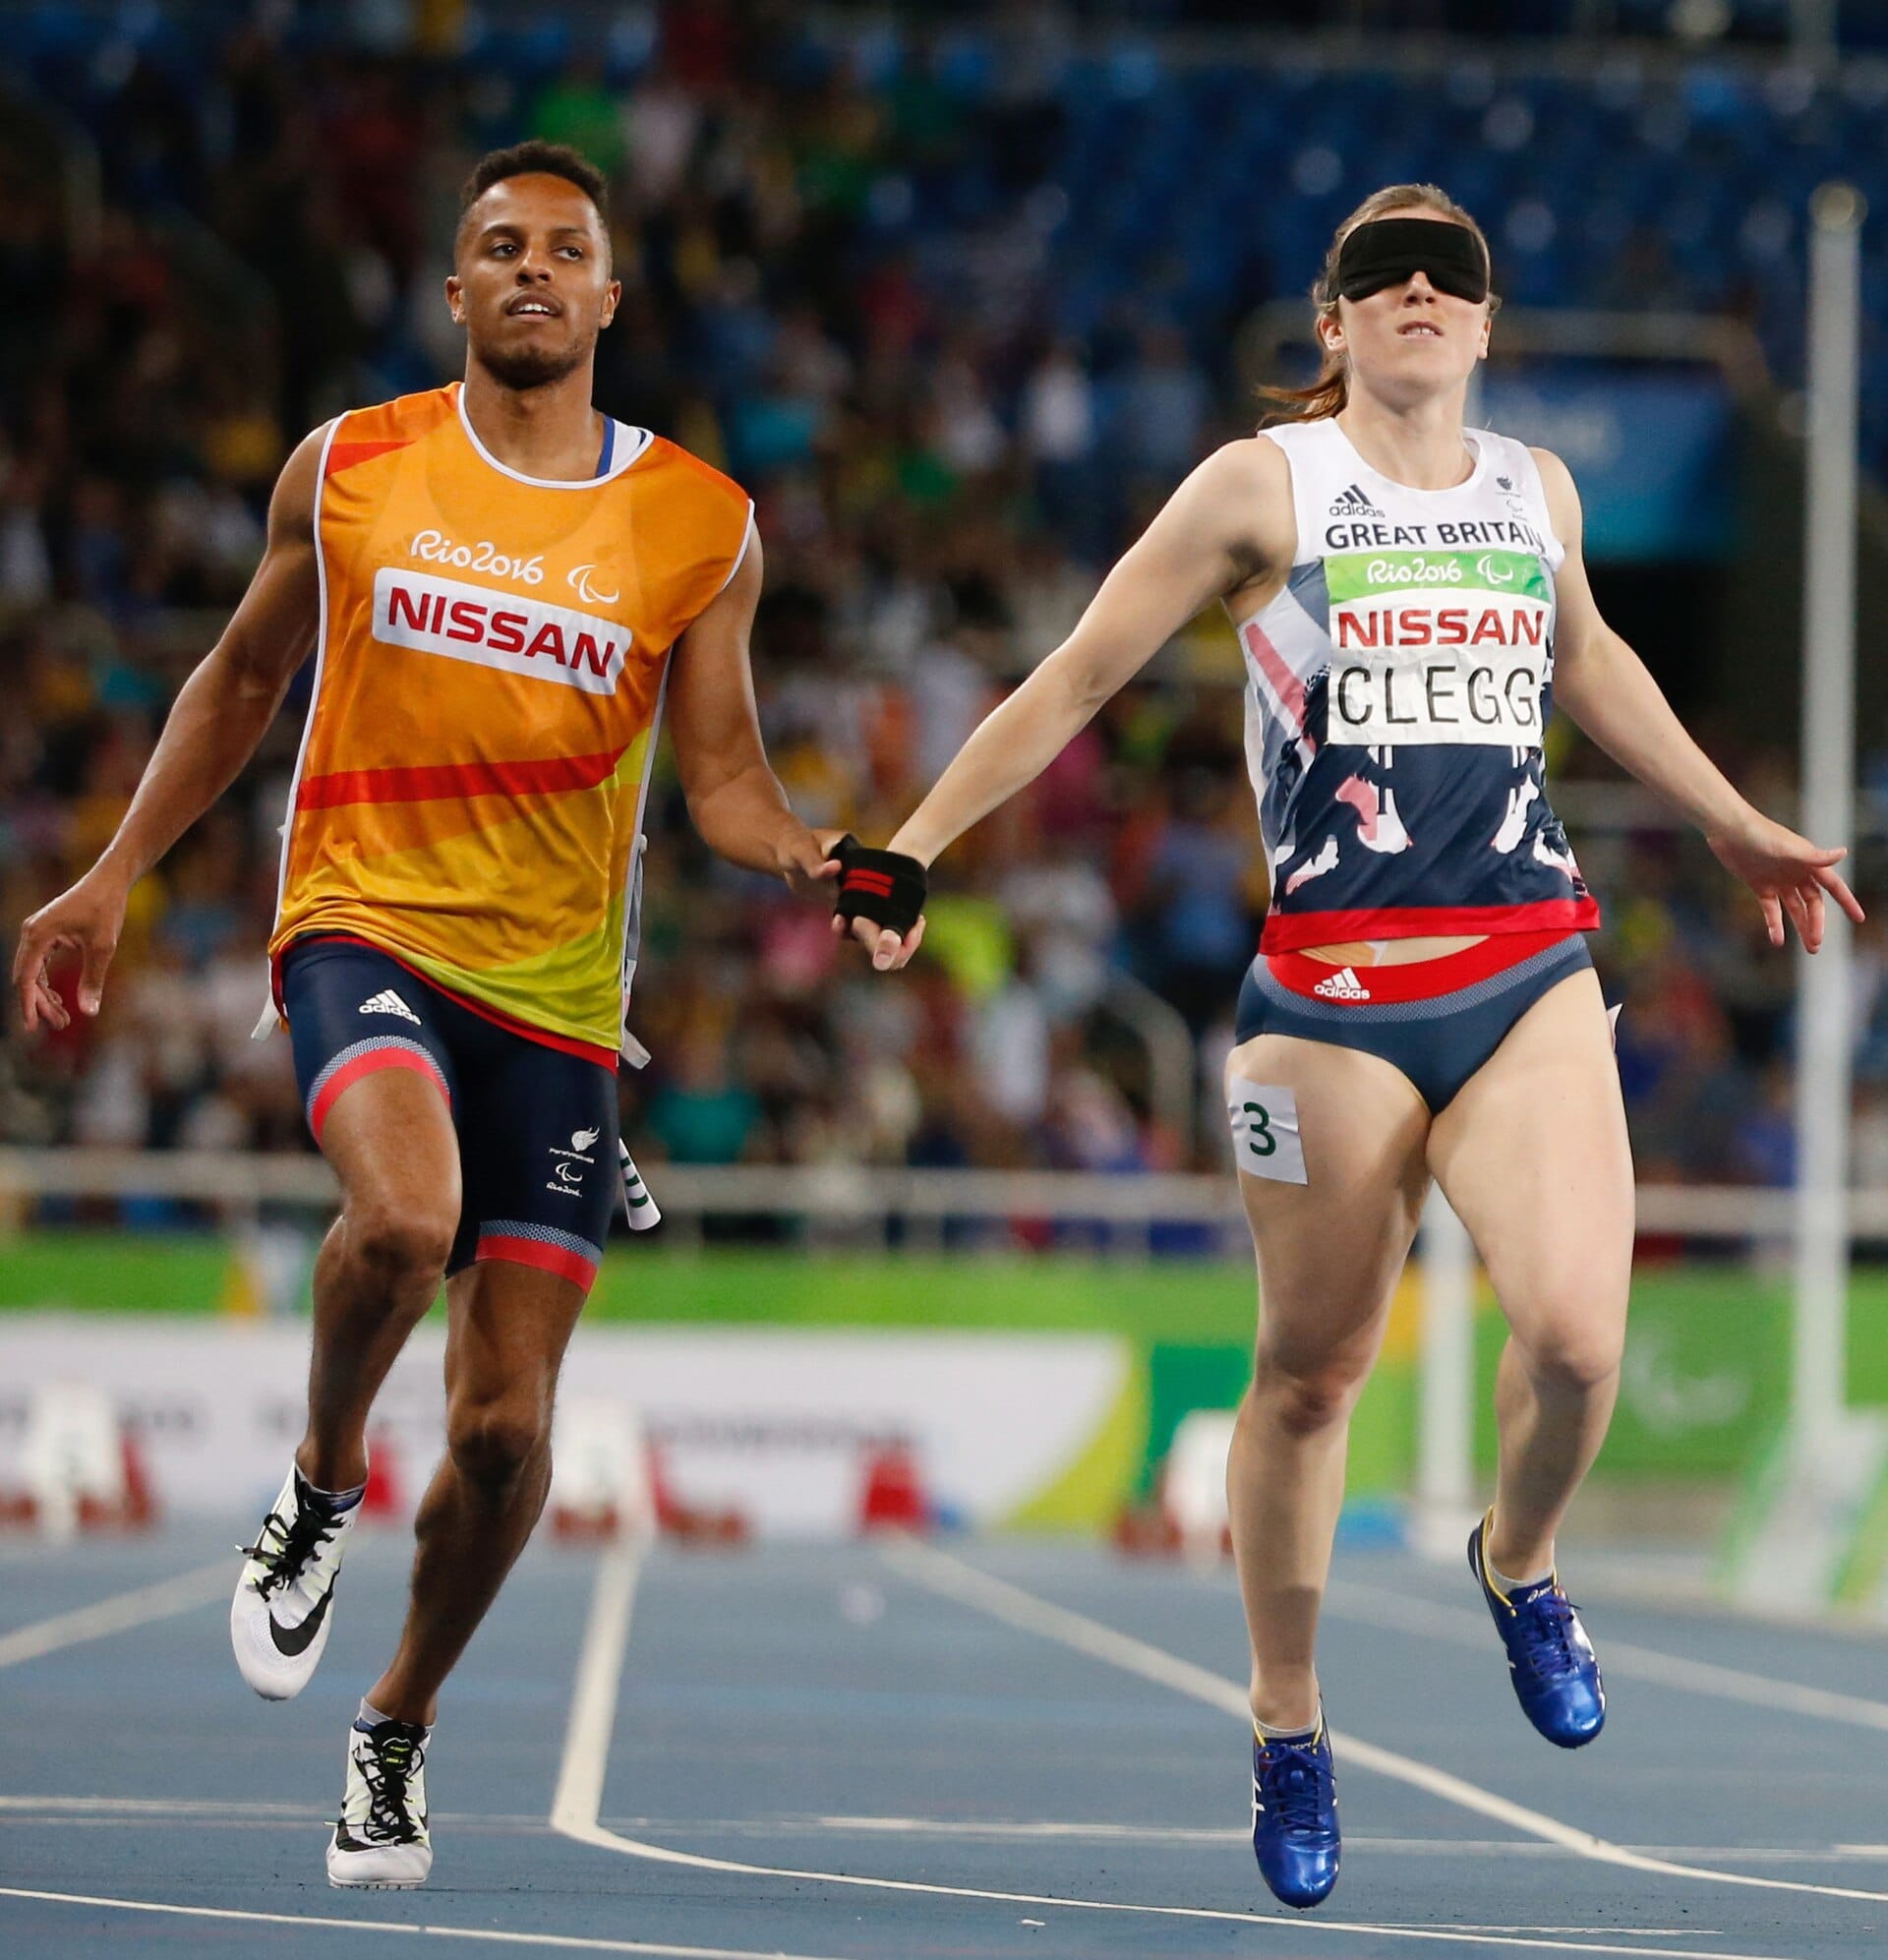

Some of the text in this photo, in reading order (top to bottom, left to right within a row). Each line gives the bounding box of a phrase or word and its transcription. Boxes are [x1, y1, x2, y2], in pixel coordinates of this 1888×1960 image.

[1328, 503, 1386, 518] adidas
[1325, 523, 1427, 549] GREAT
[410, 529, 545, 585] Rio2016
[1367, 558, 1462, 584] Rio2016
[388, 586, 616, 678] NISSAN
[1338, 609, 1544, 648] NISSAN
[1337, 665, 1537, 726] CLEGG
[1314, 983, 1371, 1000] adidas
[358, 1003, 422, 1026] adidas
[1243, 1101, 1276, 1157] 3
